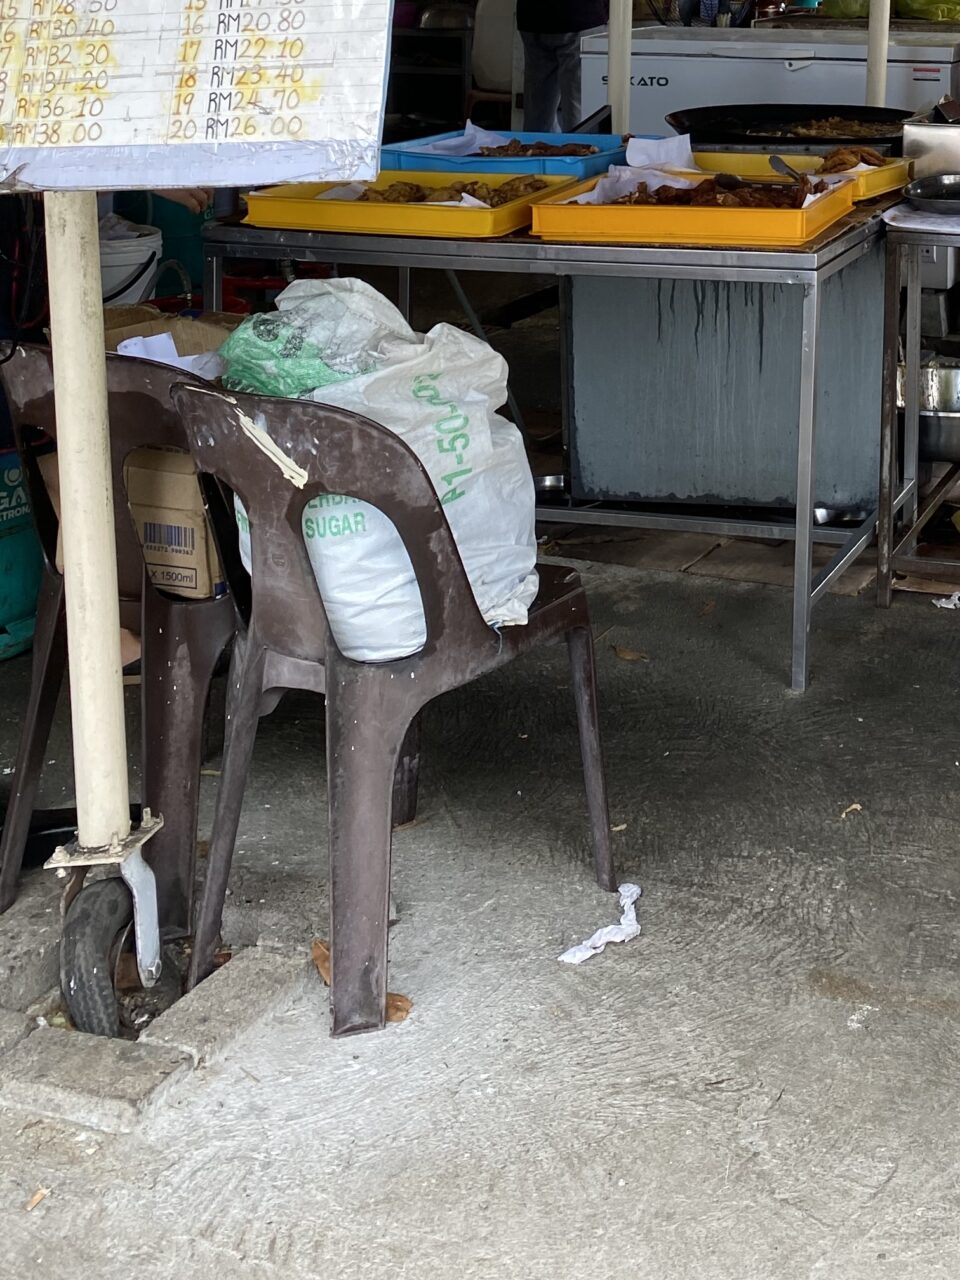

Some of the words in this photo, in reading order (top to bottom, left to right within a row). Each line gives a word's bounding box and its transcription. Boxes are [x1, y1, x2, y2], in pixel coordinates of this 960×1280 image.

[182, 15, 205, 36] 16
[178, 40, 202, 63] 17
[176, 67, 198, 88] 18
[172, 92, 195, 116] 19
[169, 119, 197, 140] 20
[305, 511, 366, 539] SUGAR
[161, 571, 193, 583] 1500ml
